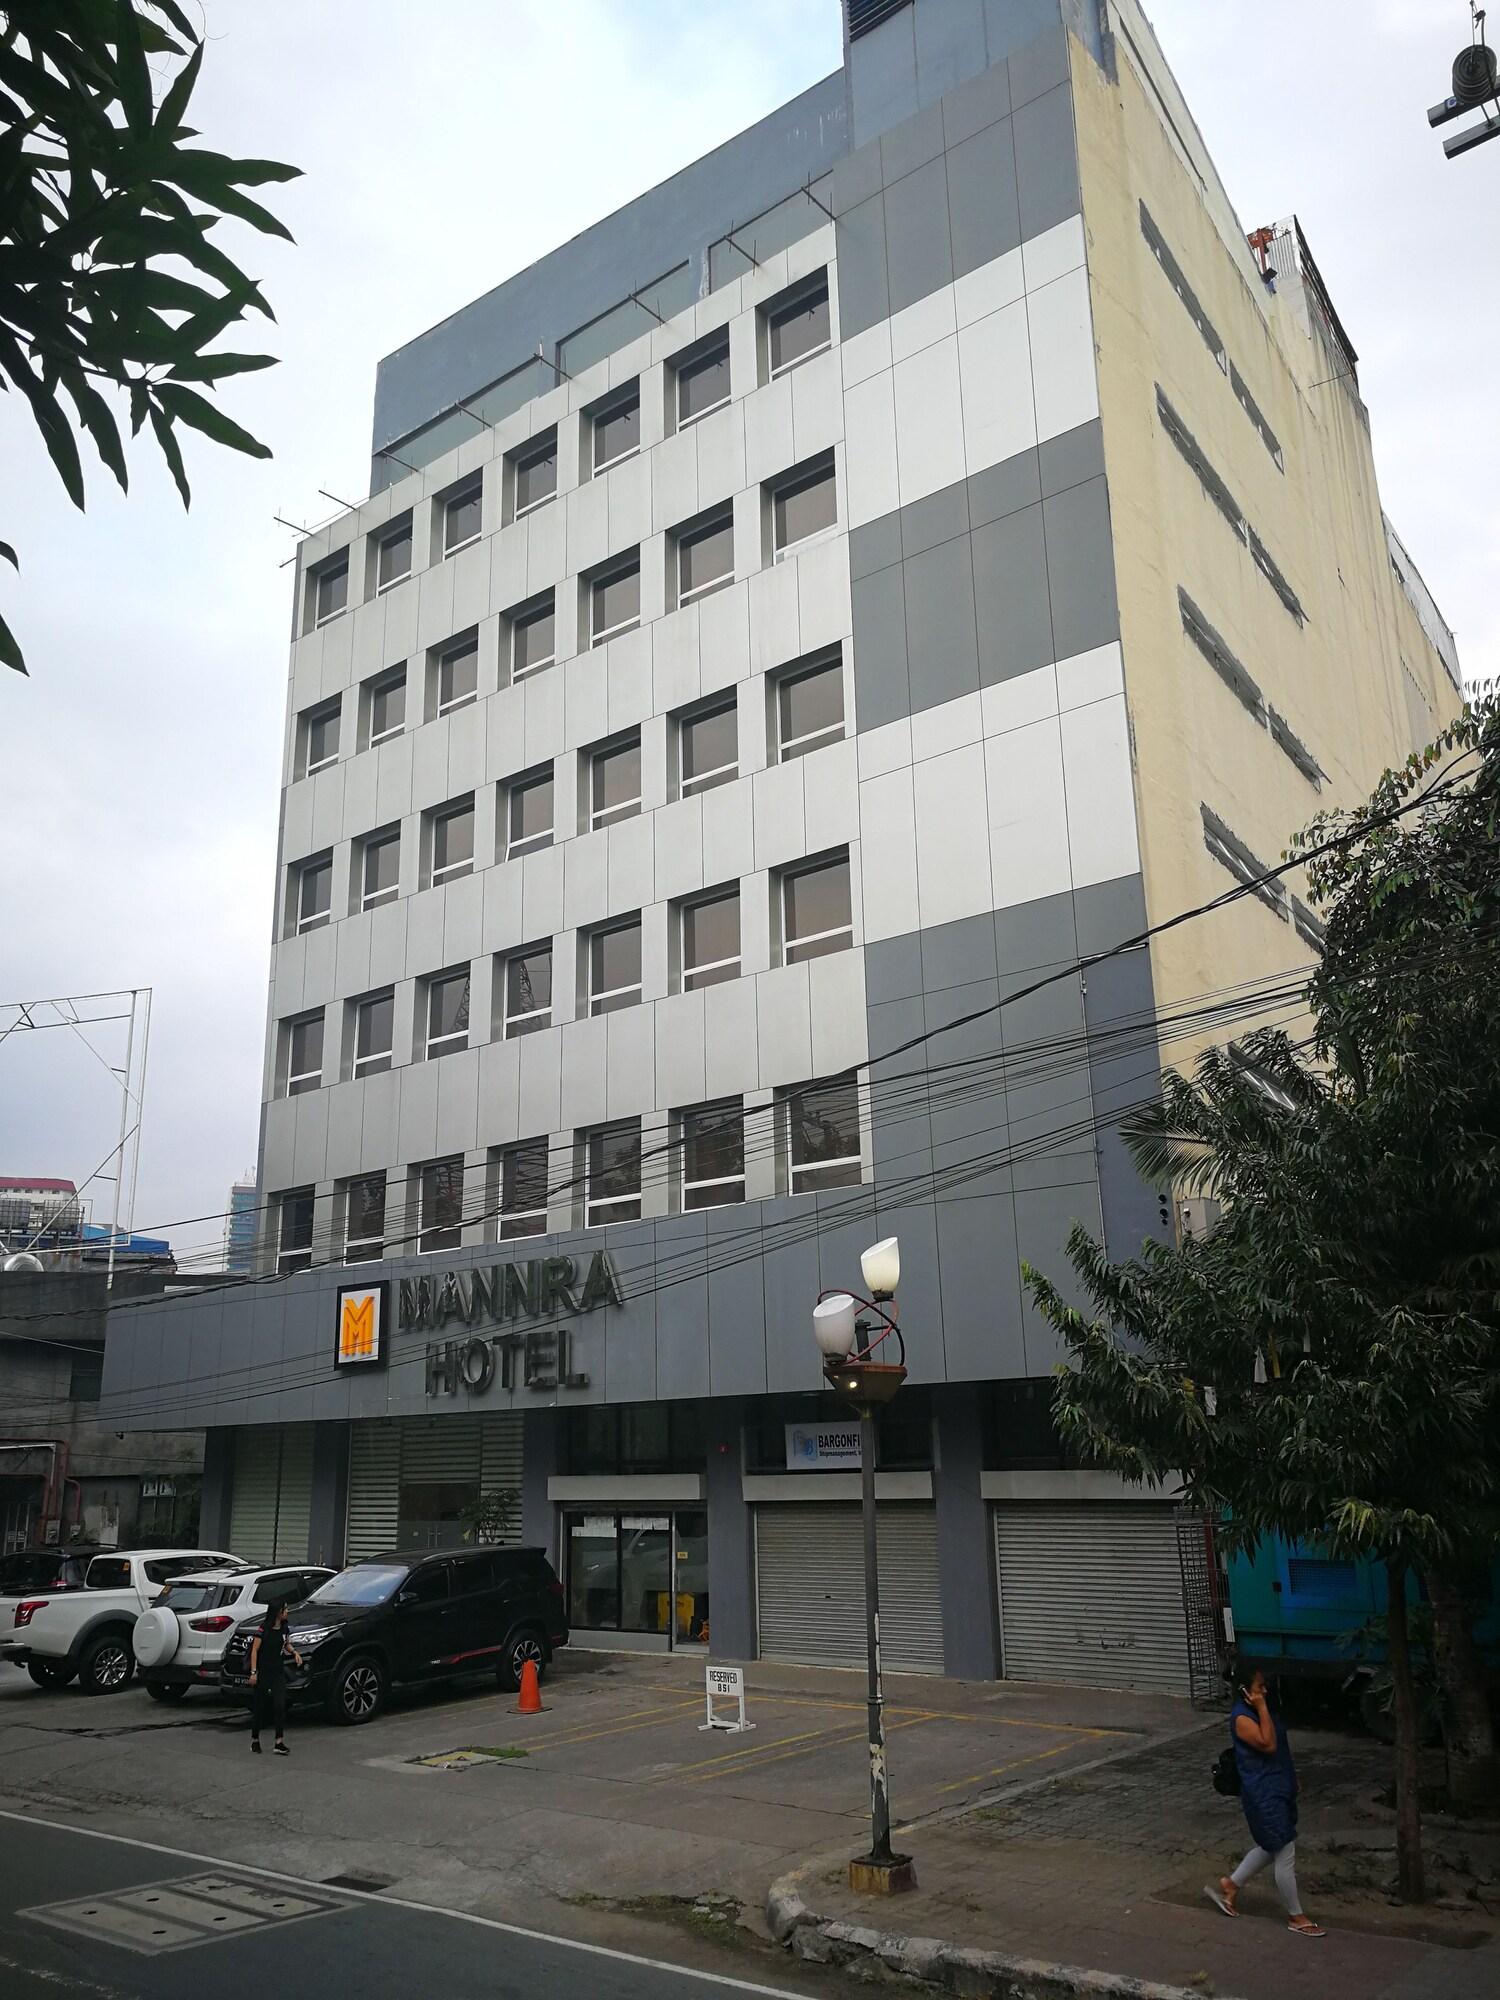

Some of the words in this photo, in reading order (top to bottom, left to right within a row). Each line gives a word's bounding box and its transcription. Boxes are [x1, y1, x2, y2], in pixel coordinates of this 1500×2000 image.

[399, 1249, 623, 1329] MANNRA
[425, 1329, 590, 1395] HOTEL
[710, 1671, 738, 1683] RESERVED
